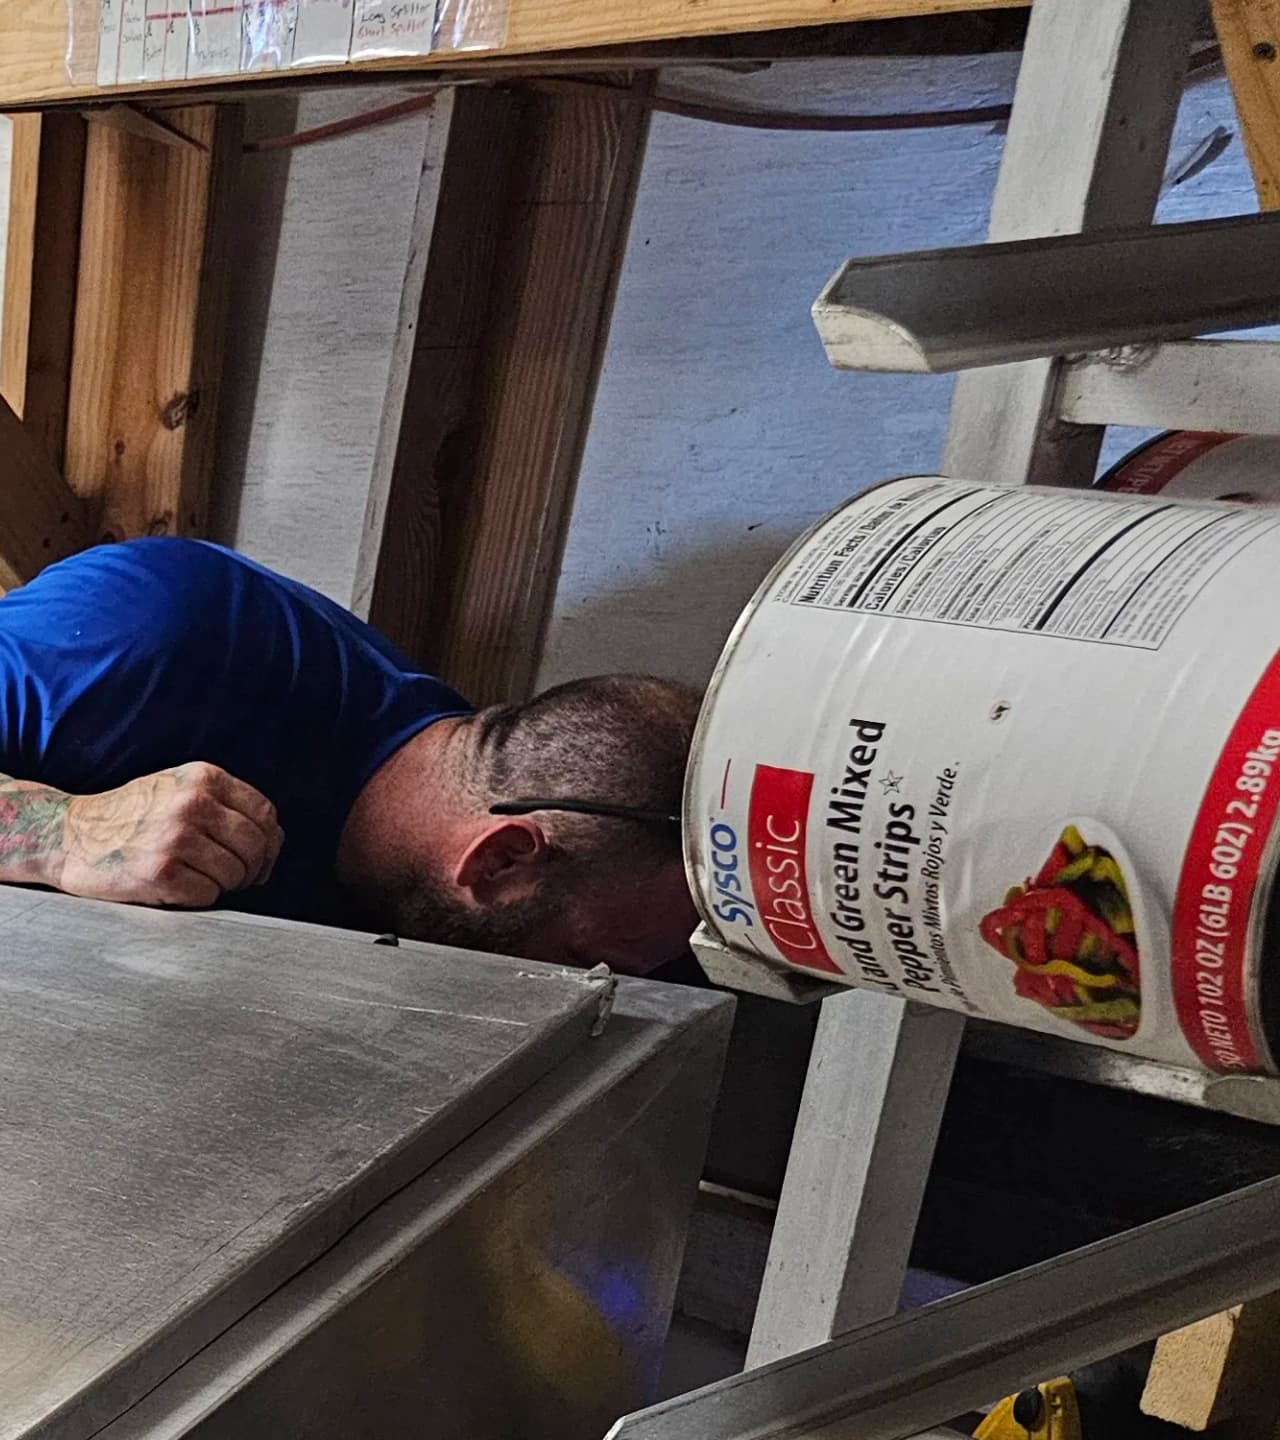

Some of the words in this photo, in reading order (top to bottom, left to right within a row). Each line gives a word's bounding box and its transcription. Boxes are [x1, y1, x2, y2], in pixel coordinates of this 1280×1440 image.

[797, 557, 843, 604] Nutrition
[825, 717, 885, 833] Mixed
[929, 818, 951, 834] y
[1210, 818, 1255, 879] 6OZ)
[877, 800, 920, 902] Strips
[921, 834, 946, 879] Rojos
[755, 813, 819, 951] Classic
[829, 842, 864, 930] Green
[925, 882, 943, 930] Mixtos
[1201, 881, 1232, 937] (6LB
[835, 935, 887, 979] and
[885, 909, 940, 990] Pepper
[1197, 939, 1222, 968] OZ
[1199, 972, 1224, 1004] 102
[1203, 1010, 1239, 1052] NETO
